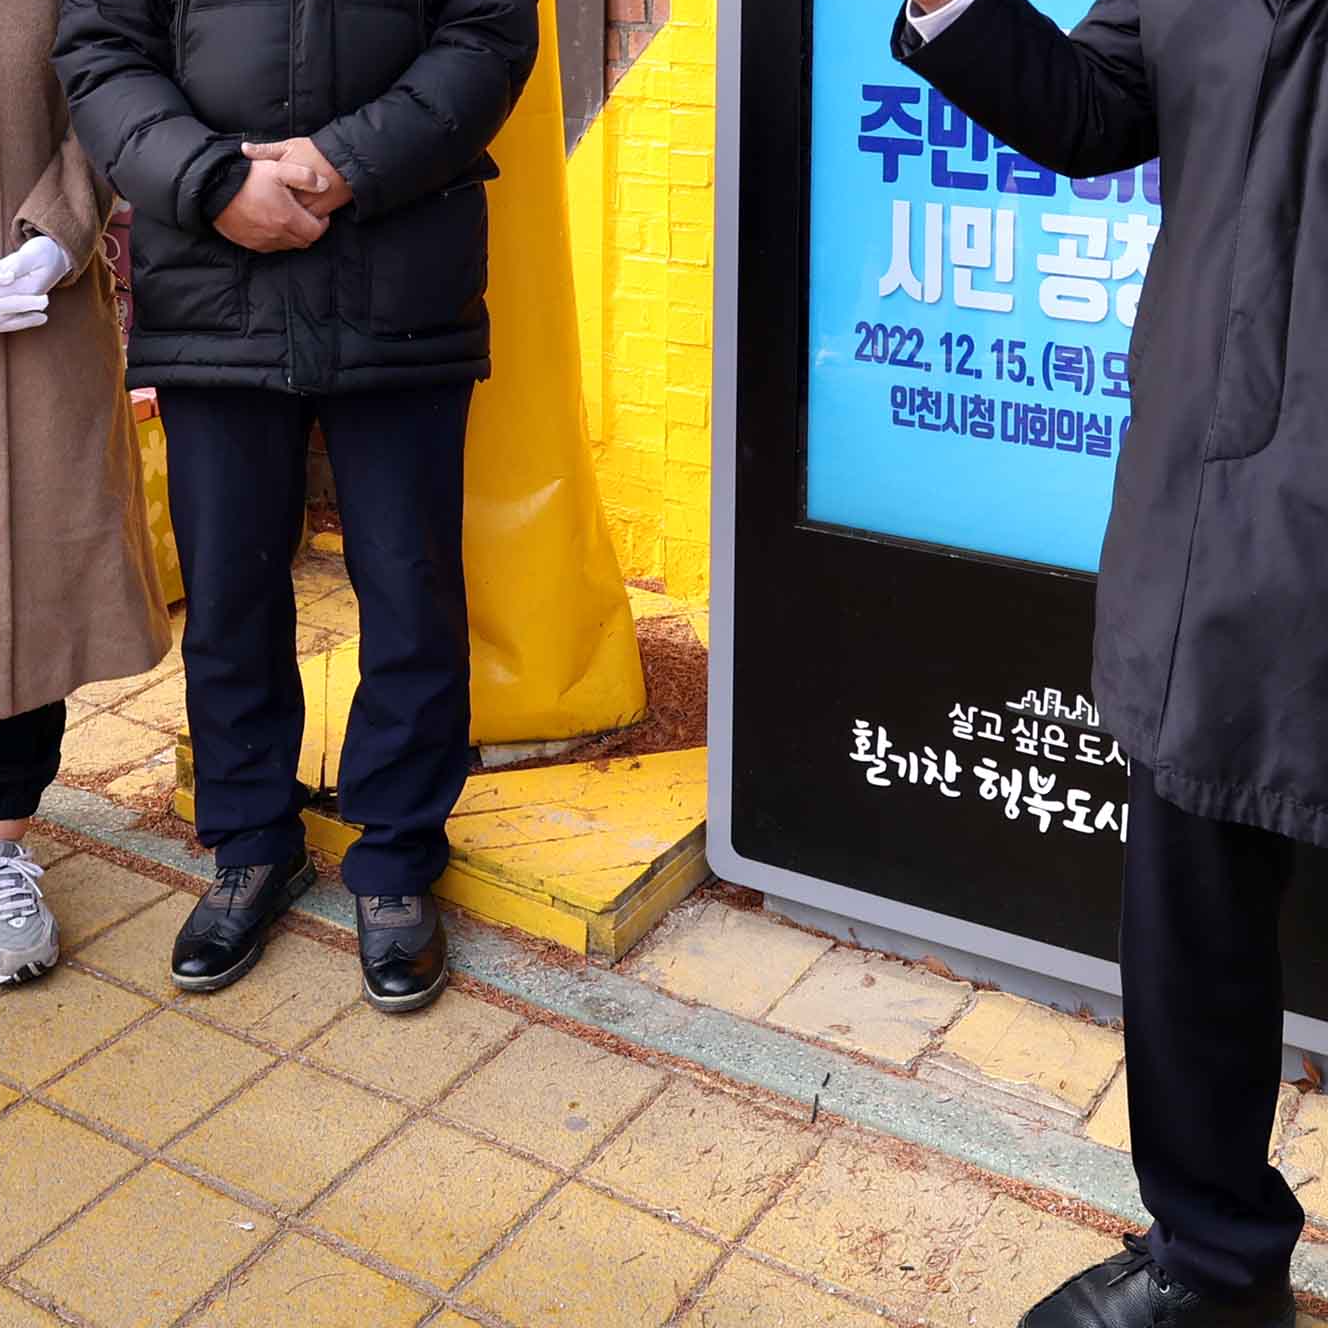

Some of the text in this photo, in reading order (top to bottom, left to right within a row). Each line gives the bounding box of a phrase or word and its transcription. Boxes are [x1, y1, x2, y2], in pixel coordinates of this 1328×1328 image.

[878, 199, 1016, 313] 시민
[890, 384, 1112, 458] 인천시청 대회의실
[947, 703, 1005, 742] 살고
[1010, 717, 1069, 762] 싶은
[848, 718, 1130, 843] 활기찬 행복도시
